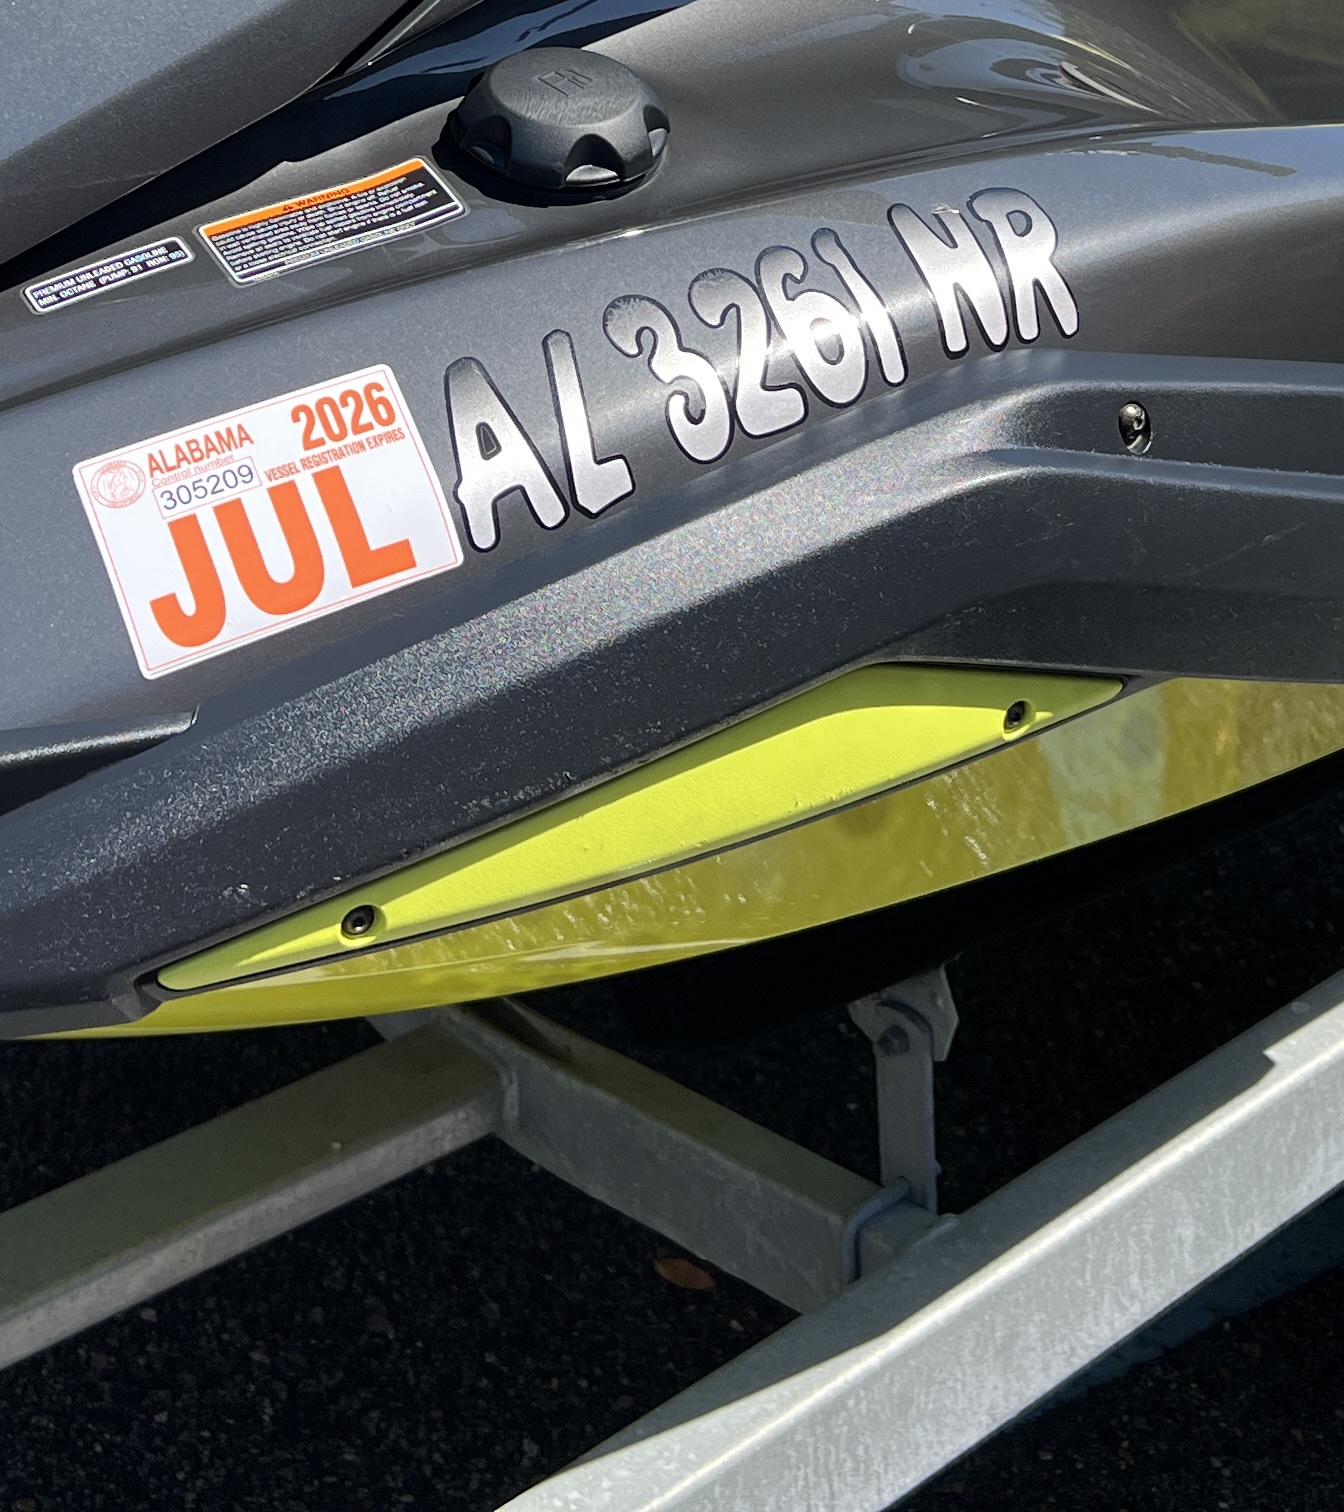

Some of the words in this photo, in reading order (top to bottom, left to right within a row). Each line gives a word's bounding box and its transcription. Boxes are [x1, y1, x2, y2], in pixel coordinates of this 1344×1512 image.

[295, 188, 351, 207] WARNING
[33, 278, 77, 299] PREMIUM
[76, 261, 124, 284] UNLEADED
[124, 246, 169, 266] GASOLINE
[38, 295, 61, 307] MIN.
[60, 282, 97, 299] OCTANE
[442, 329, 635, 552] AL
[603, 228, 908, 464] 3261
[886, 187, 1081, 360] NR
[291, 382, 397, 452] 2026
[147, 423, 255, 478] ALABAMA
[152, 468, 192, 488] Control
[193, 454, 234, 475] number
[264, 461, 301, 482] VESSEL
[299, 439, 367, 471] REGISTRATION
[365, 426, 407, 450] EXPIRES
[160, 464, 254, 510] 305209
[149, 464, 417, 648] JUL
